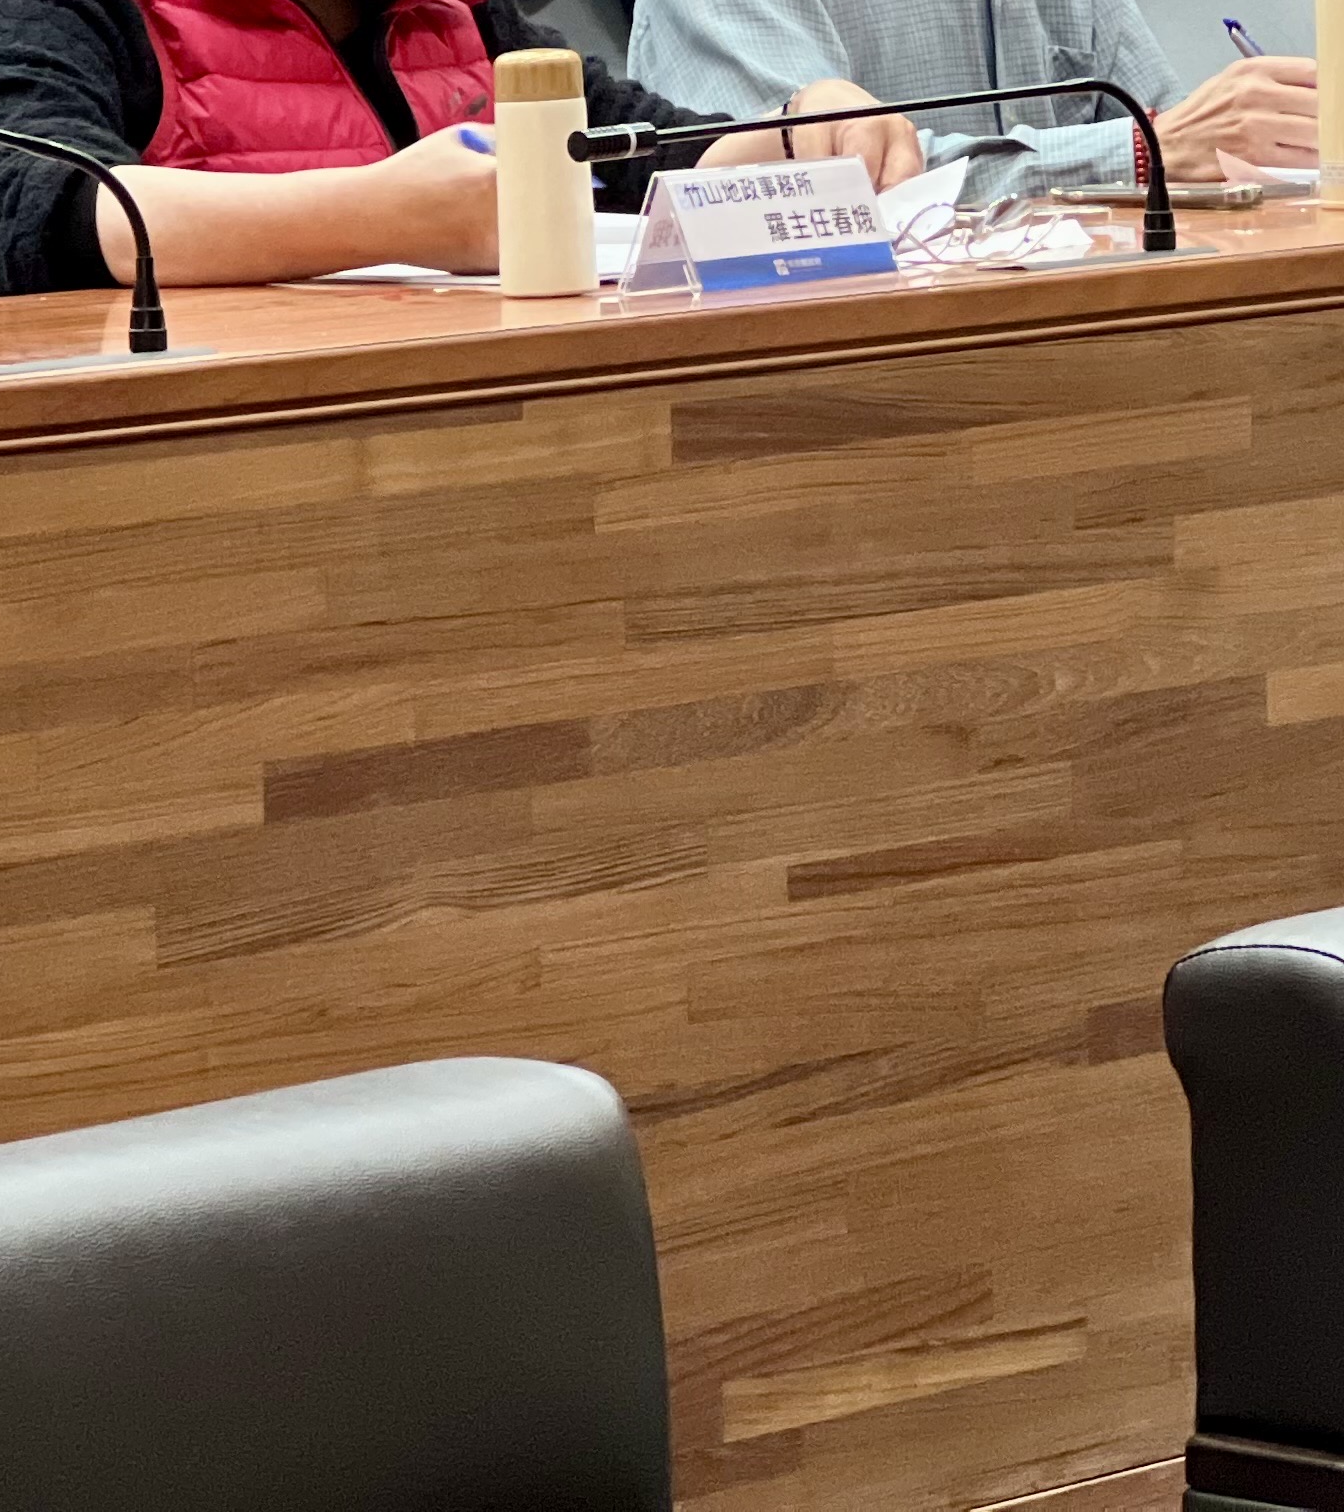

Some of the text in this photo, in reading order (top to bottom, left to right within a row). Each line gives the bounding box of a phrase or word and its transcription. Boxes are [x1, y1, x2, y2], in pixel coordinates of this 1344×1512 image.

[683, 171, 815, 209] 竹山地政事務所
